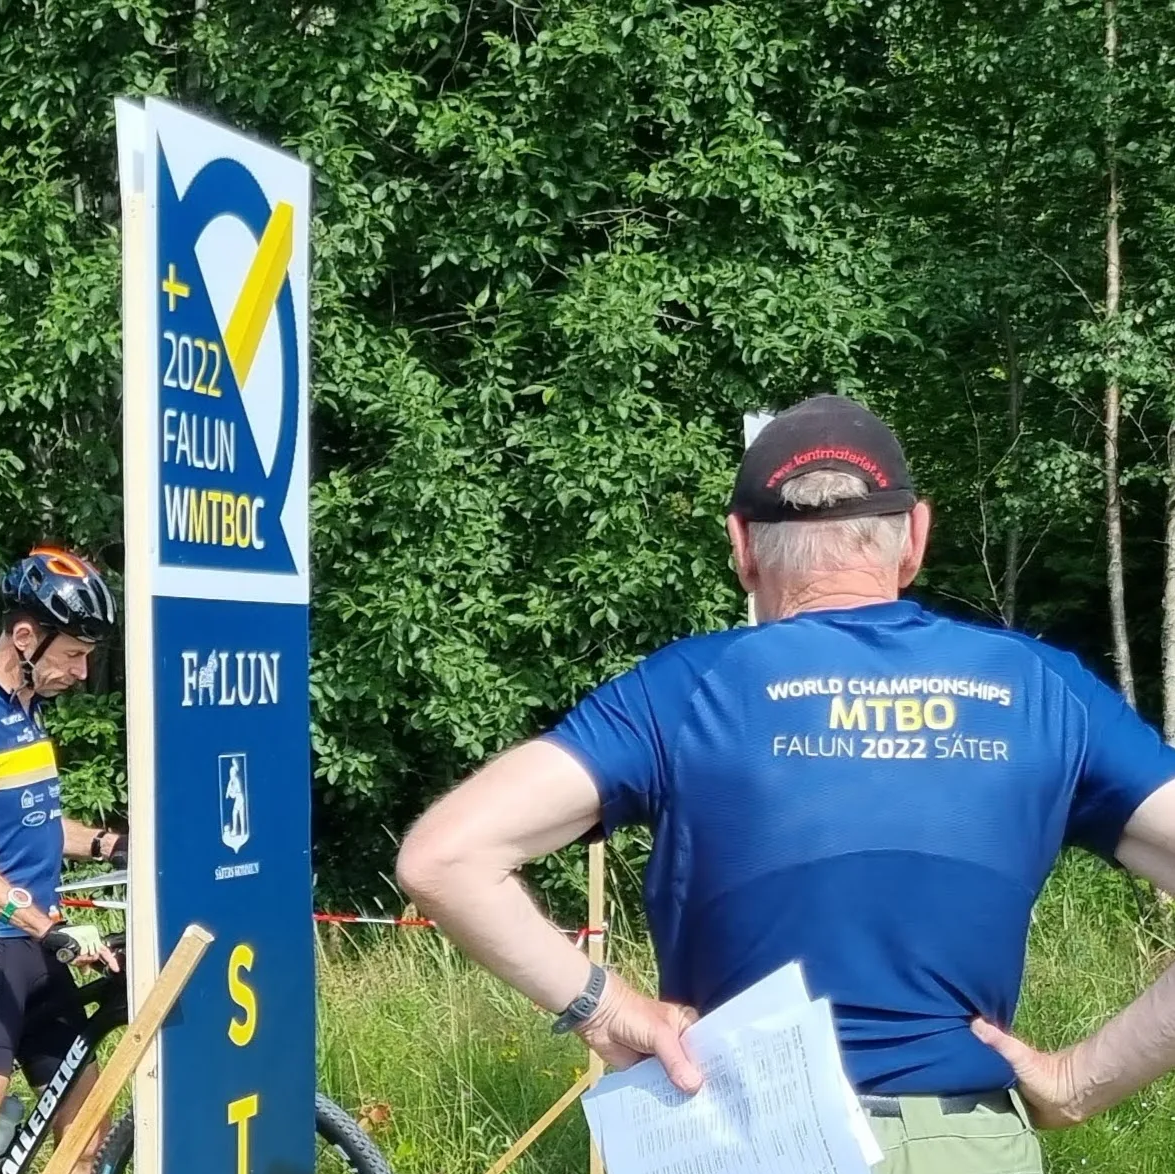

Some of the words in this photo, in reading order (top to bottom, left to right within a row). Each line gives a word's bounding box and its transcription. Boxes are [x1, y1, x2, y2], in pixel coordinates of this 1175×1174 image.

[163, 331, 222, 397] 2022
[163, 408, 236, 473] FALUN
[164, 484, 265, 550] WMTBOC
[767, 678, 842, 701] WORLD
[848, 677, 1011, 706] CHAMPIONSHIPS
[829, 697, 955, 732] MTBO
[773, 736, 854, 757] FALUN
[861, 738, 926, 759] 2022
[934, 733, 1009, 761] SÄTER
